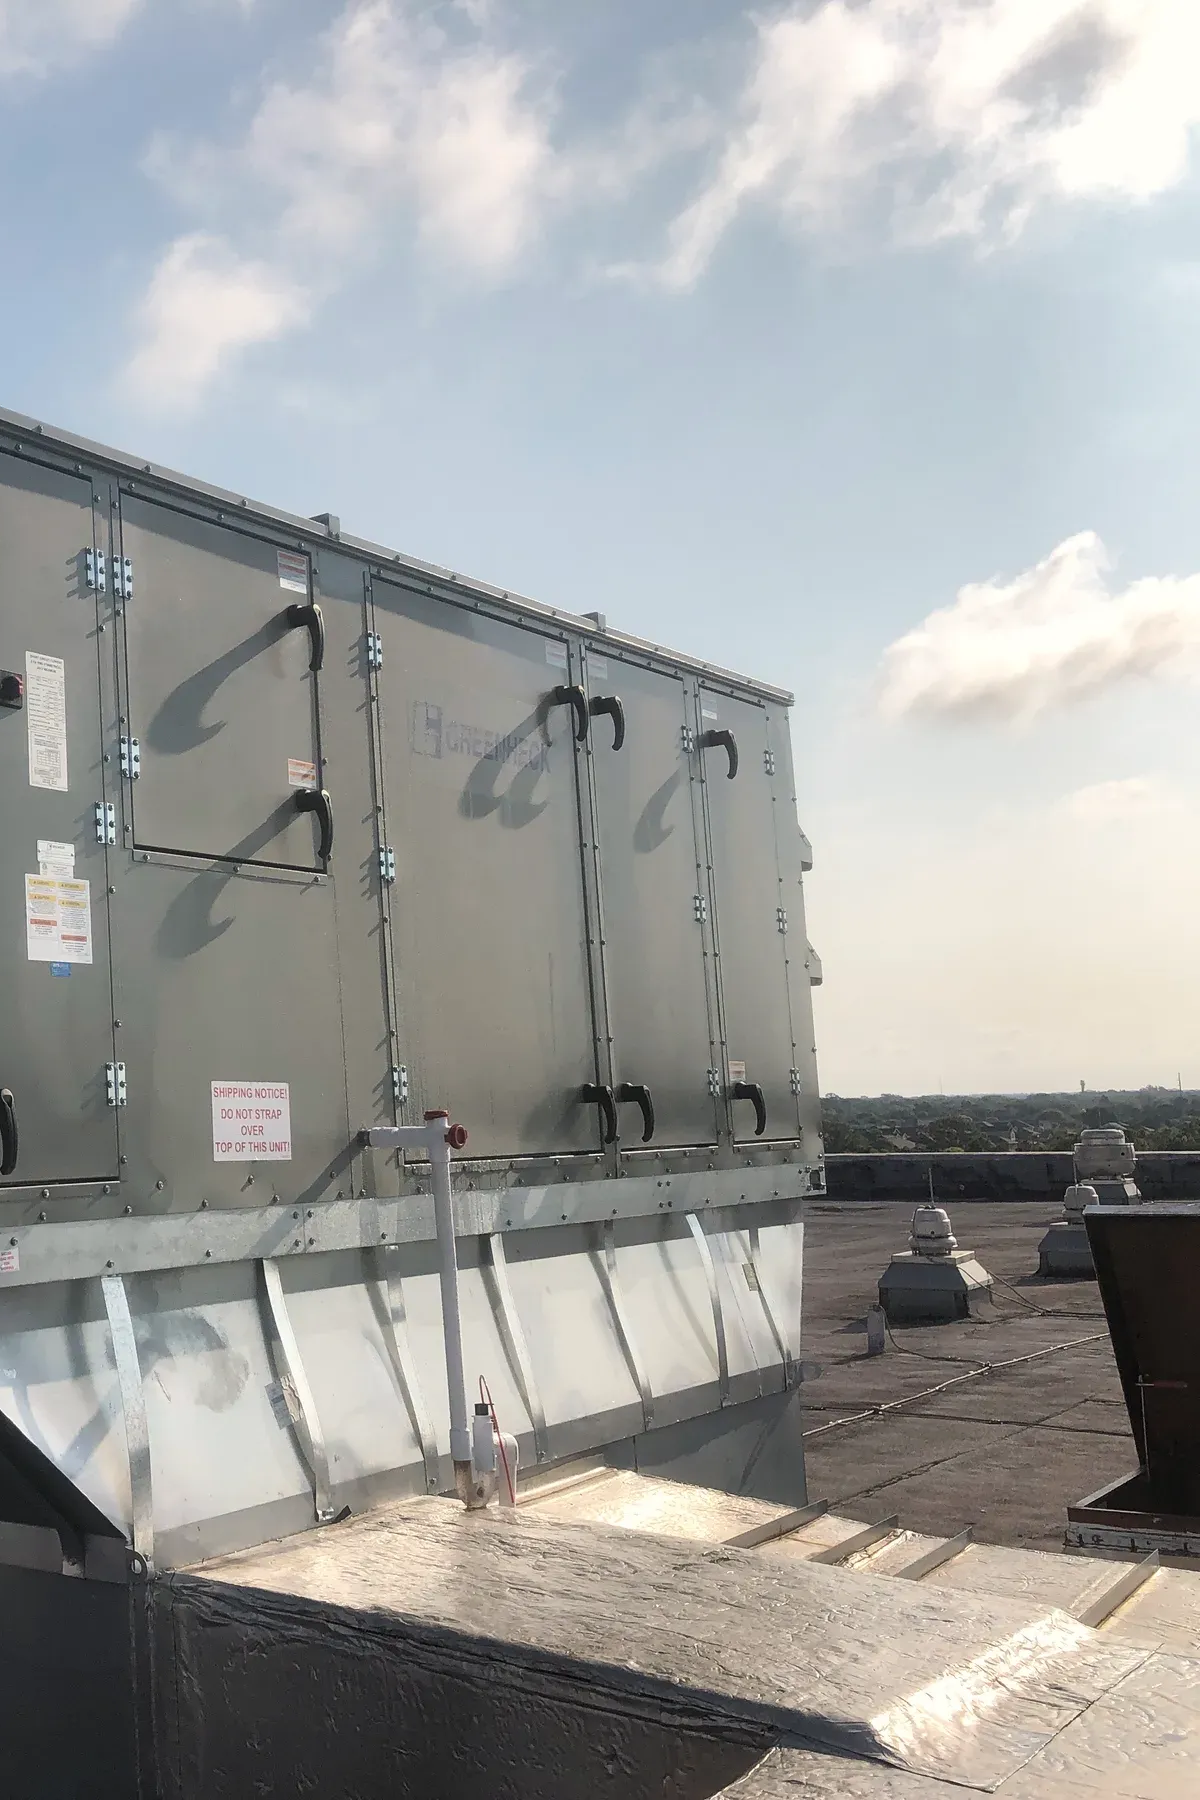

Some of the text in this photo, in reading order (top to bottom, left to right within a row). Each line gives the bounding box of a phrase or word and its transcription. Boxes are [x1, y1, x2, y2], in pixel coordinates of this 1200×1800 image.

[213, 1086, 288, 1099] SHIPPING NOTICE!
[220, 1108, 282, 1120] DO NOT STRAP
[240, 1125, 264, 1136] OVER
[215, 1141, 290, 1153] TOP OF THIS UNIT!
